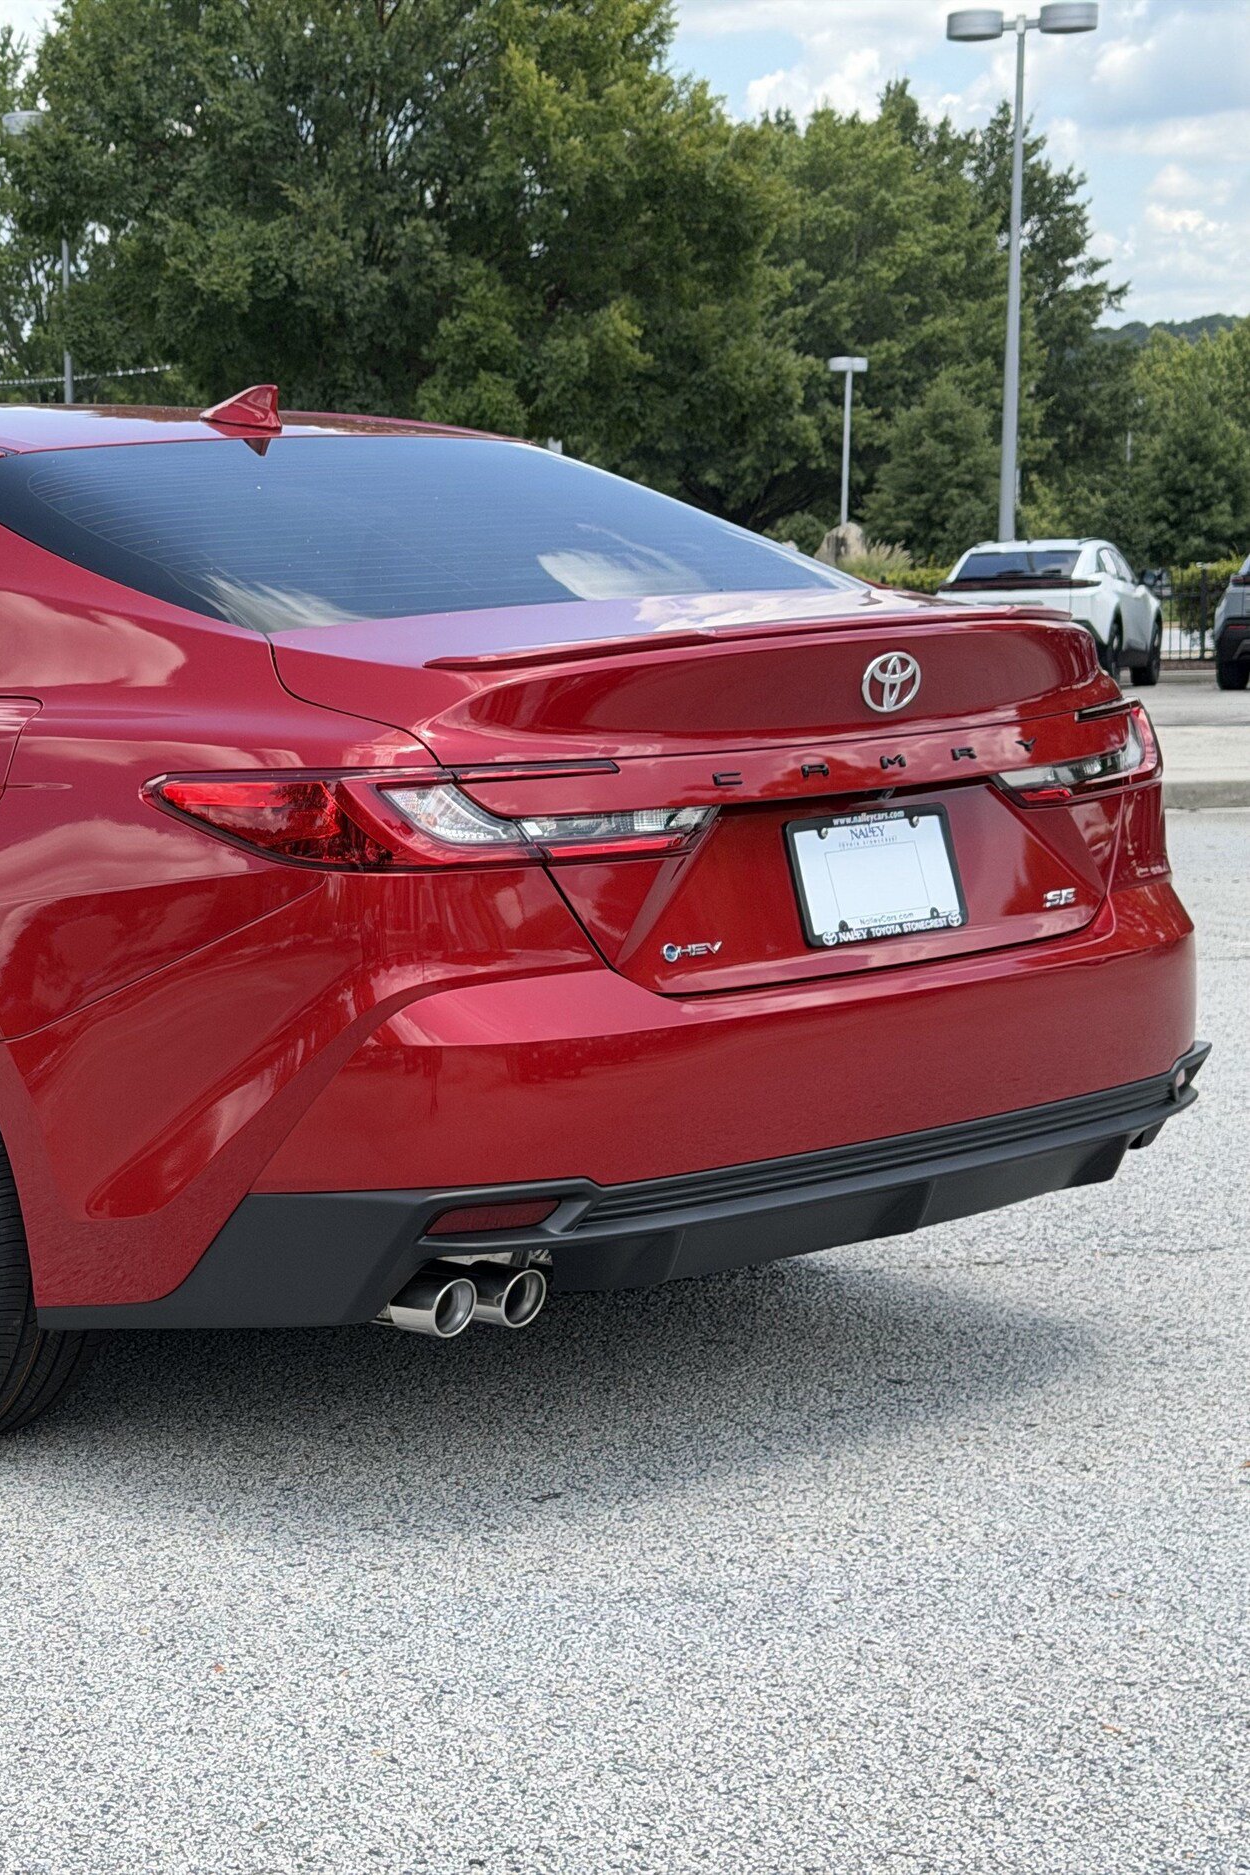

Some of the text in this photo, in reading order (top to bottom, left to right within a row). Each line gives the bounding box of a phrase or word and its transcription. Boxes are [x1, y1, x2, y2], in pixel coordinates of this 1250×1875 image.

[712, 737, 1037, 787] CAMRY
[832, 810, 905, 826] www.nalleycars.com
[849, 823, 886, 840] NALLEY
[1043, 887, 1077, 909] SE
[859, 911, 915, 926] NalleyCars.com
[838, 917, 948, 943] NALLEY TOYOTA STONECREST
